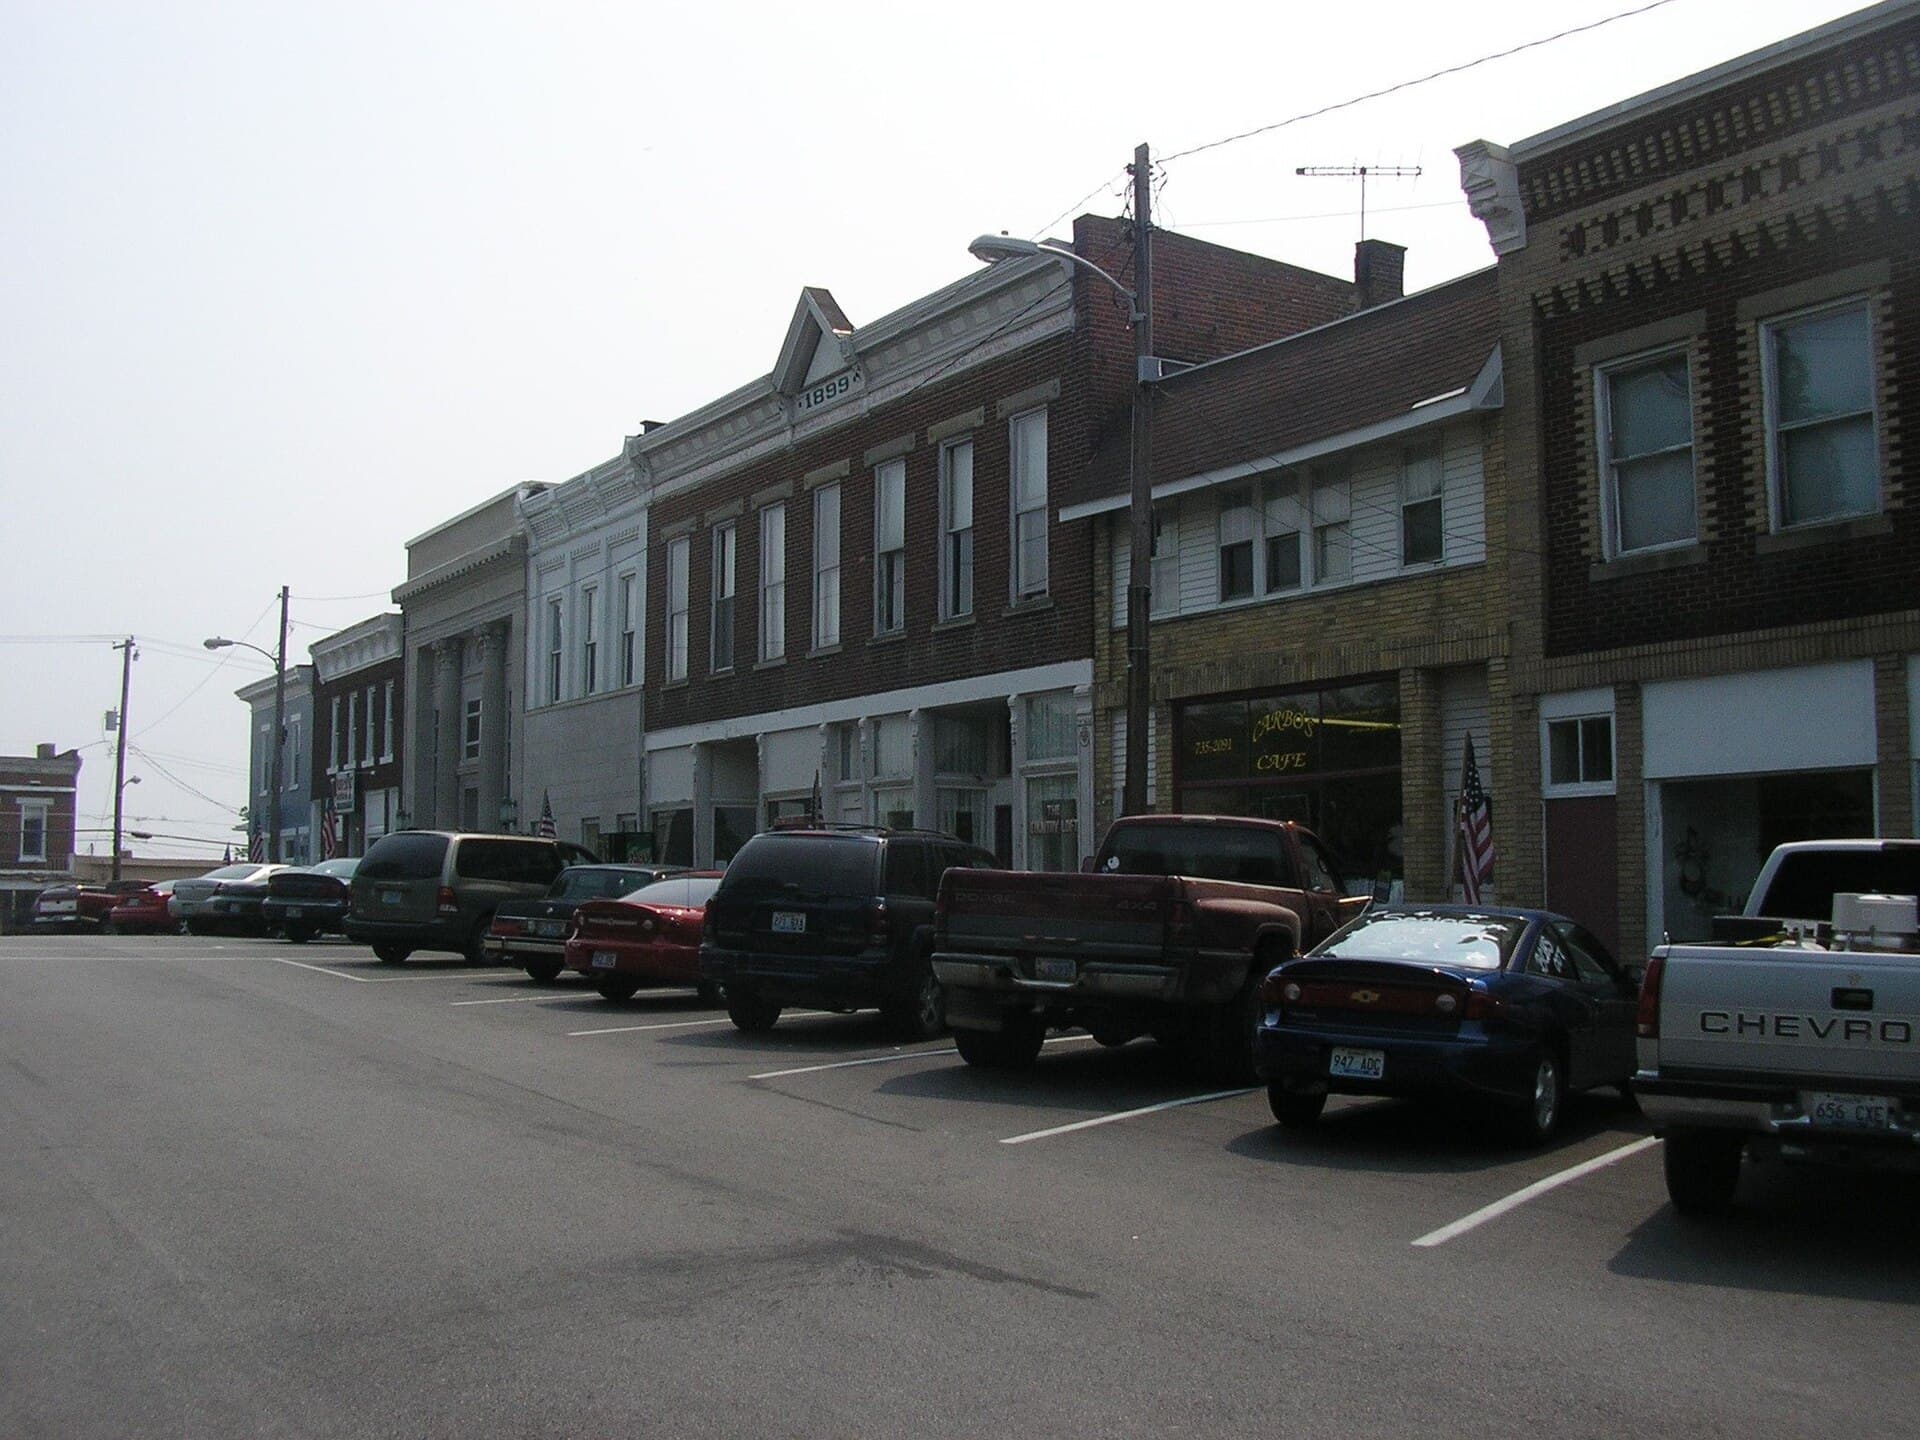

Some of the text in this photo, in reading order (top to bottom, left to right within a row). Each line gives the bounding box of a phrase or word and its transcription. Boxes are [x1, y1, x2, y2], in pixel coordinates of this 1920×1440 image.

[807, 378, 849, 408] 1899
[1252, 710, 1316, 742] CARBO'S
[1256, 752, 1306, 770] CAFE
[1334, 1054, 1354, 1068] 947
[1816, 1102, 1845, 1119] 656
